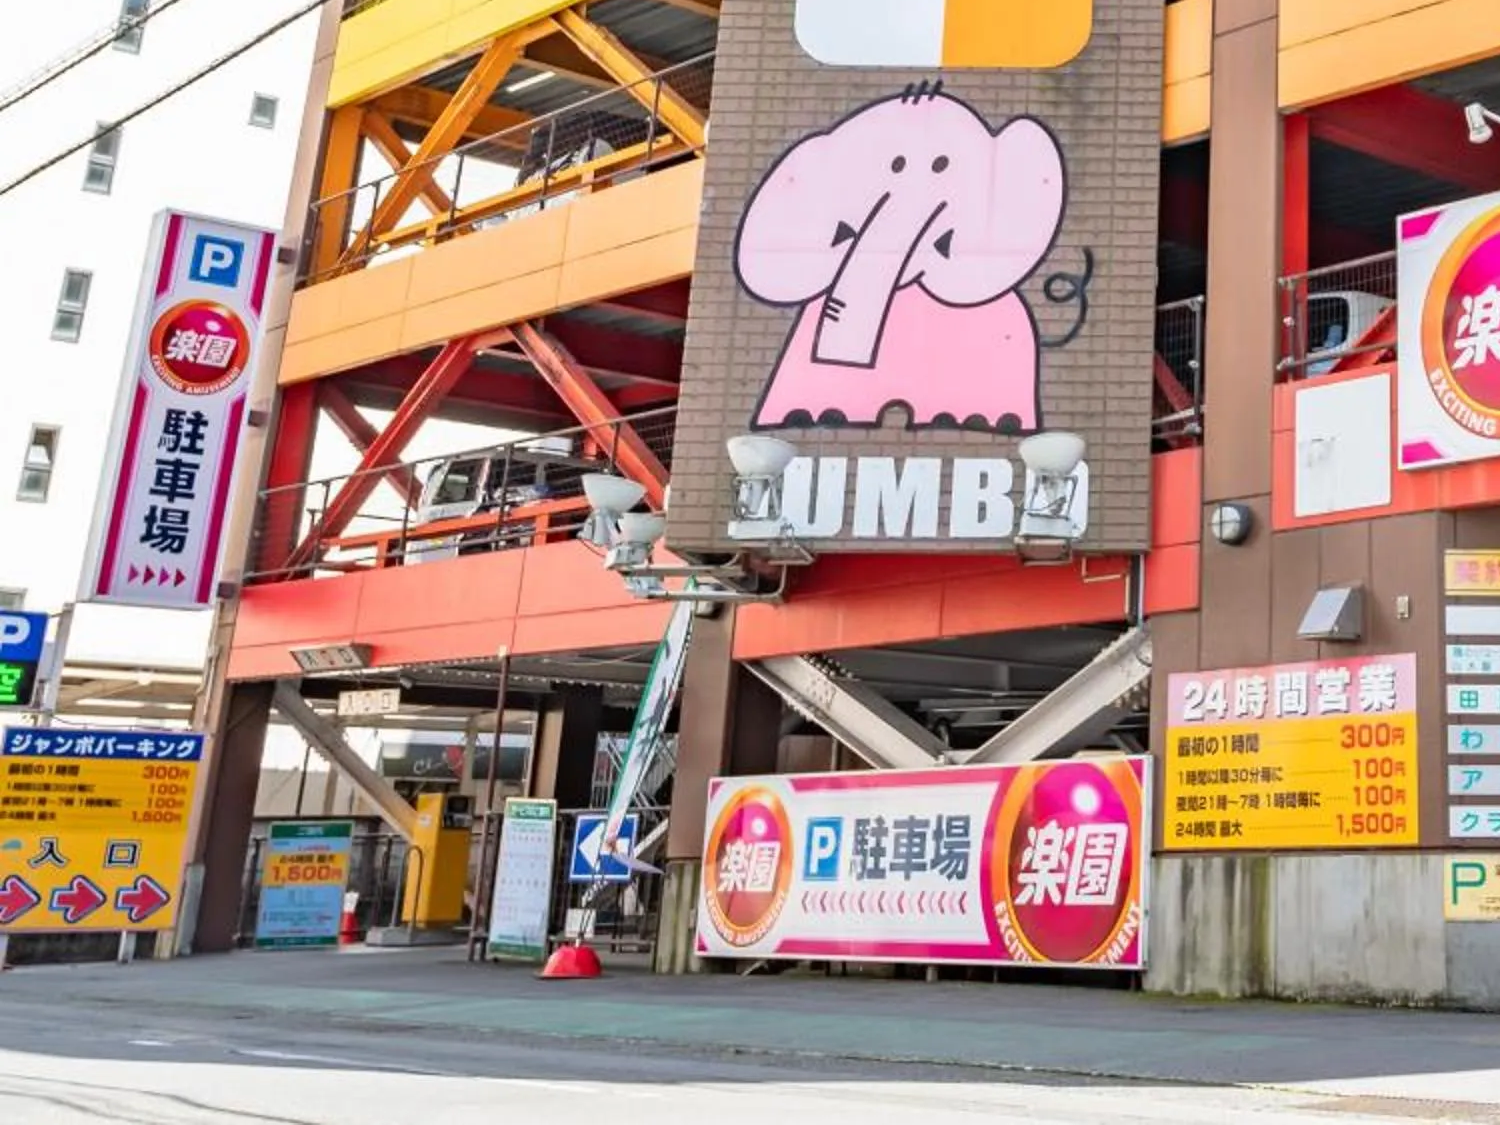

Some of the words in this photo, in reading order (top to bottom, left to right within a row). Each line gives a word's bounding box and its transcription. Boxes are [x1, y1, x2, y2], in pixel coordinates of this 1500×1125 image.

[199, 242, 235, 278] P
[164, 328, 238, 369] 楽園
[1429, 366, 1497, 436] EXCITING
[139, 407, 209, 555] 駐車場
[1183, 664, 1397, 721] 24時間営業
[1340, 722, 1405, 749] 300円
[1352, 757, 1406, 780] 100円
[1352, 784, 1406, 807] 100円
[850, 815, 972, 882] 駐車場
[1336, 813, 1407, 836] 1,500円
[717, 840, 782, 893] 楽園
[808, 824, 838, 876] P
[1014, 818, 1129, 908] 楽園
[1451, 861, 1487, 906] P
